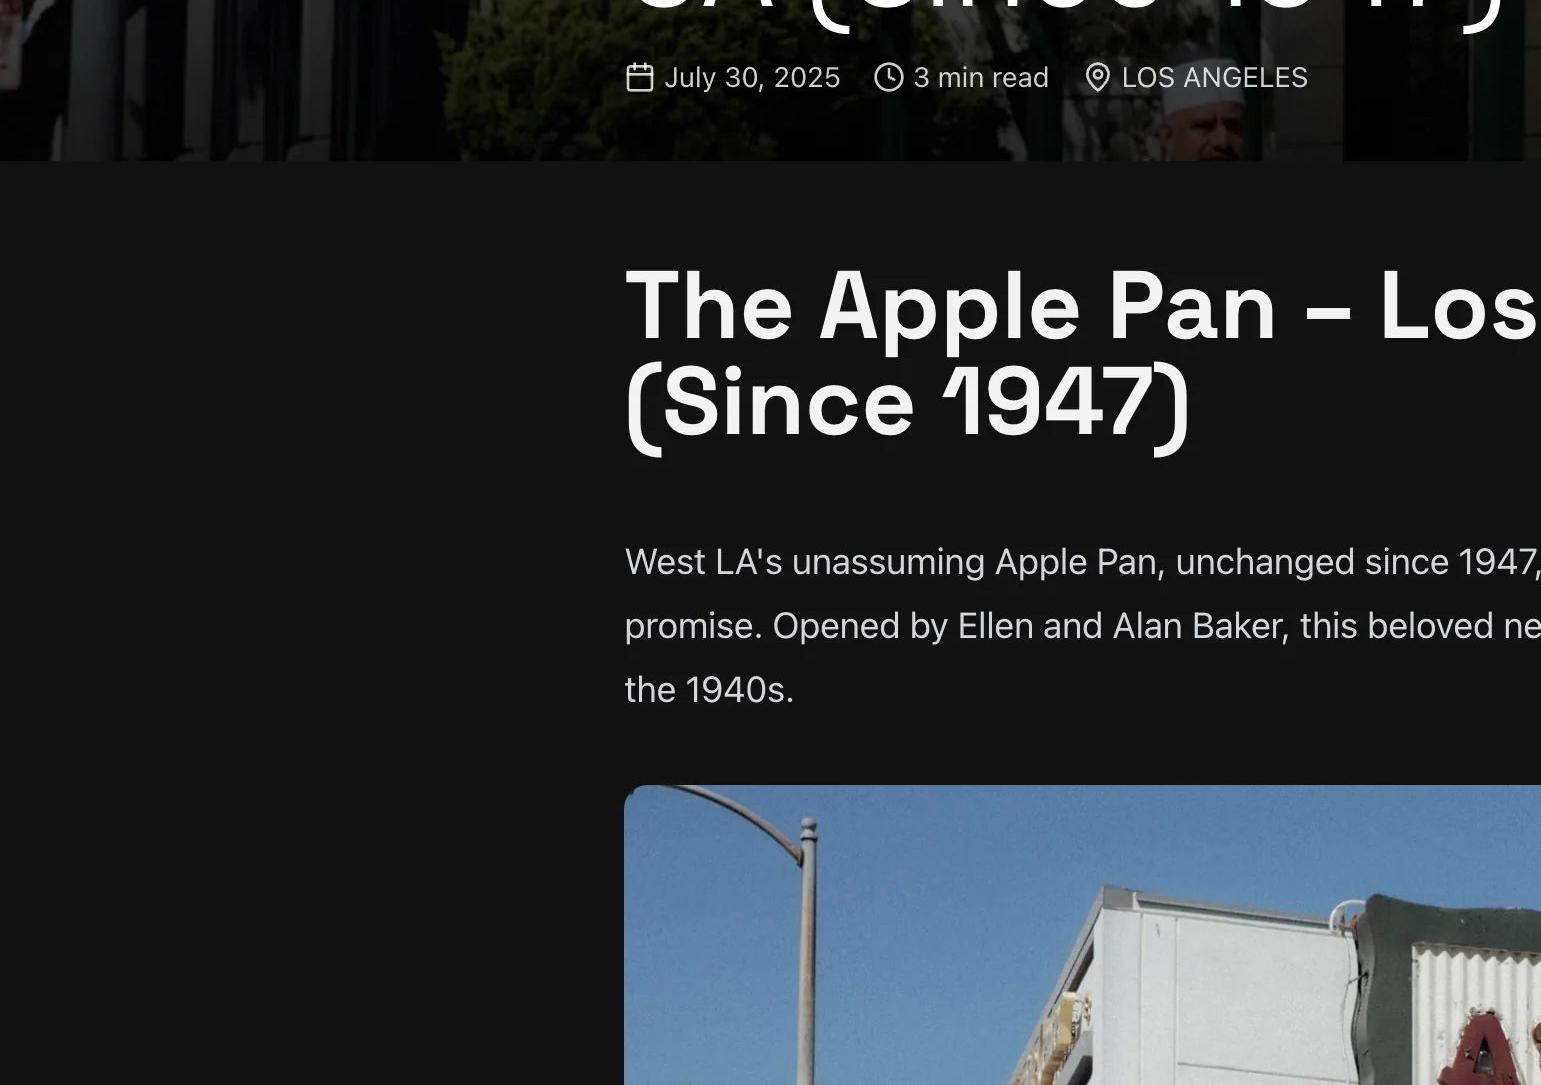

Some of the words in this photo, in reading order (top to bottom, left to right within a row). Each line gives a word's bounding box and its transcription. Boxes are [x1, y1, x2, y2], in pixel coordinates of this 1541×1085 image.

[626, 270, 791, 340] The
[820, 270, 1078, 358] Apple
[1113, 270, 1272, 340] Pan
[1384, 270, 1536, 340] Los
[628, 360, 914, 459] (Since
[942, 360, 1188, 459] 1947)
[625, 547, 706, 575] West
[717, 547, 782, 575] LA's
[793, 546, 984, 582] unassuming
[994, 546, 1088, 582] Apple
[1098, 547, 1164, 582] Pan,
[1177, 546, 1354, 582] unchanged
[1365, 546, 1449, 575] since
[1459, 547, 1541, 582] 1947,
[626, 610, 762, 646] promise.
[773, 610, 899, 646] Opened
[911, 610, 949, 646] by
[959, 610, 1033, 639] Ellen
[1043, 610, 1102, 639] and
[1112, 610, 1182, 639] Alan
[1194, 610, 1289, 646] Baker,
[1299, 610, 1358, 639] this
[1369, 610, 1493, 639] beloved
[624, 674, 676, 703] the
[686, 675, 793, 704] 1940s.
